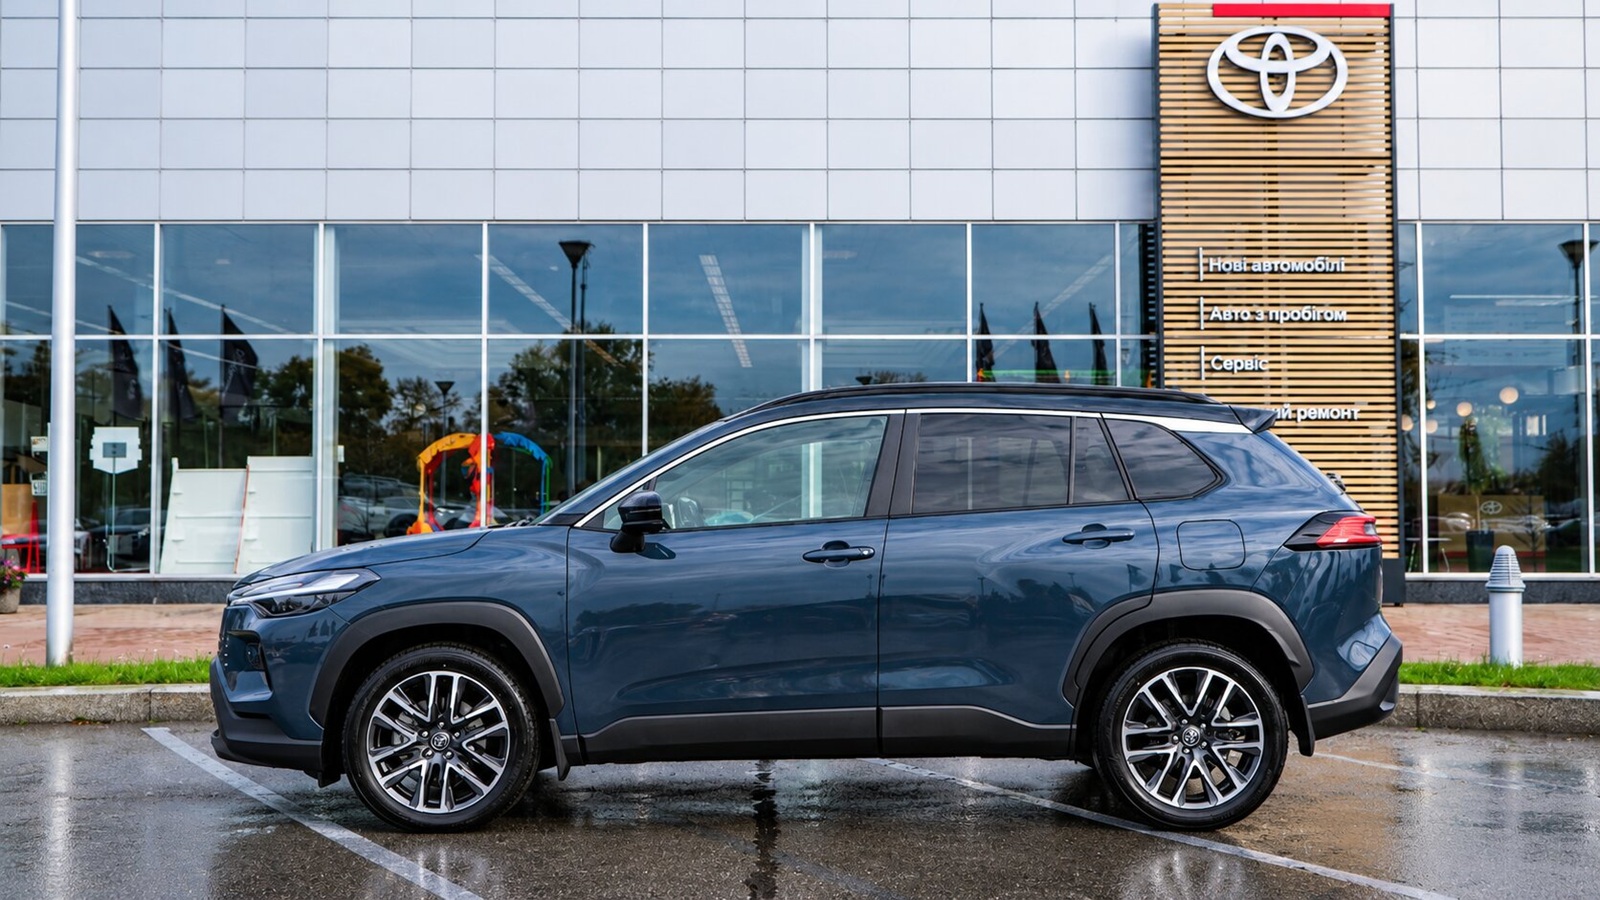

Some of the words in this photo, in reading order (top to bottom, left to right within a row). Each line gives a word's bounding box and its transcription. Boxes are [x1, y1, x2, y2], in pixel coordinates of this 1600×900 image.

[1208, 257, 1247, 272] Нові
[1251, 256, 1345, 272] автомобілі
[1209, 306, 1251, 321] Авто
[1255, 309, 1264, 321] з
[1269, 305, 1347, 324] пробігом
[1210, 355, 1269, 373] Сервіс
[1296, 407, 1361, 422] ремонт
